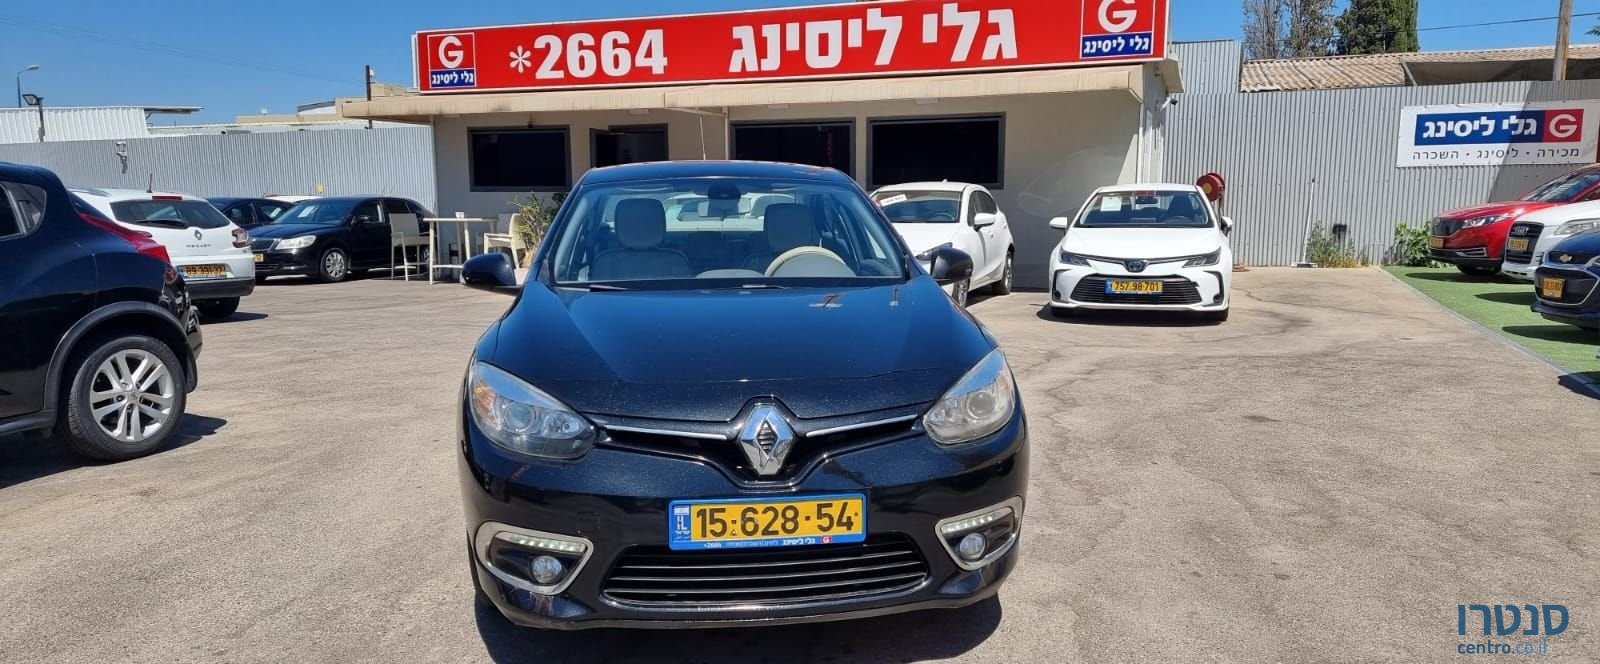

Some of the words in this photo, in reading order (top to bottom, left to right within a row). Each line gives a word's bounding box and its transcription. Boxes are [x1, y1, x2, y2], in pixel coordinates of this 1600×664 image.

[1097, 0, 1137, 33] G
[728, 7, 904, 73] ליסינג
[921, 3, 1019, 63] גלי
[438, 35, 464, 69] G
[1083, 36, 1126, 54] ליסינג
[1129, 35, 1150, 51] גלי
[431, 71, 459, 85] ליסינג
[460, 71, 474, 84] גלי
[1422, 116, 1496, 139] ליסינג
[1502, 115, 1537, 136] גלי
[1549, 113, 1578, 138] G
[1412, 150, 1459, 161] השכרה
[1476, 147, 1519, 160] ליסינג
[1537, 147, 1580, 158] מכירה
